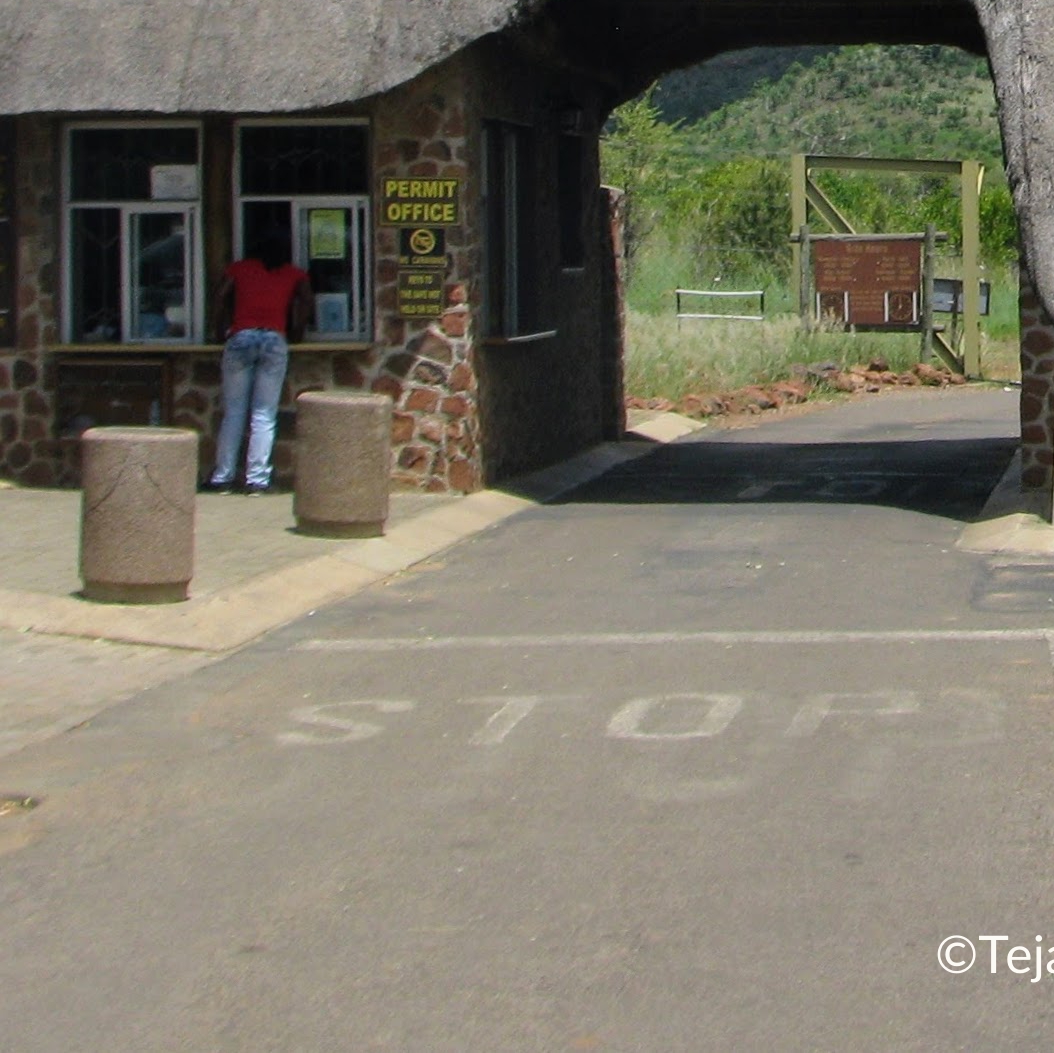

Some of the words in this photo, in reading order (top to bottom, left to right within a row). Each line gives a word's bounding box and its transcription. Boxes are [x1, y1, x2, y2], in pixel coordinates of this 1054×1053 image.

[385, 180, 458, 198] PERMIT
[387, 203, 455, 221] OFFICE
[275, 692, 921, 746] STOP
